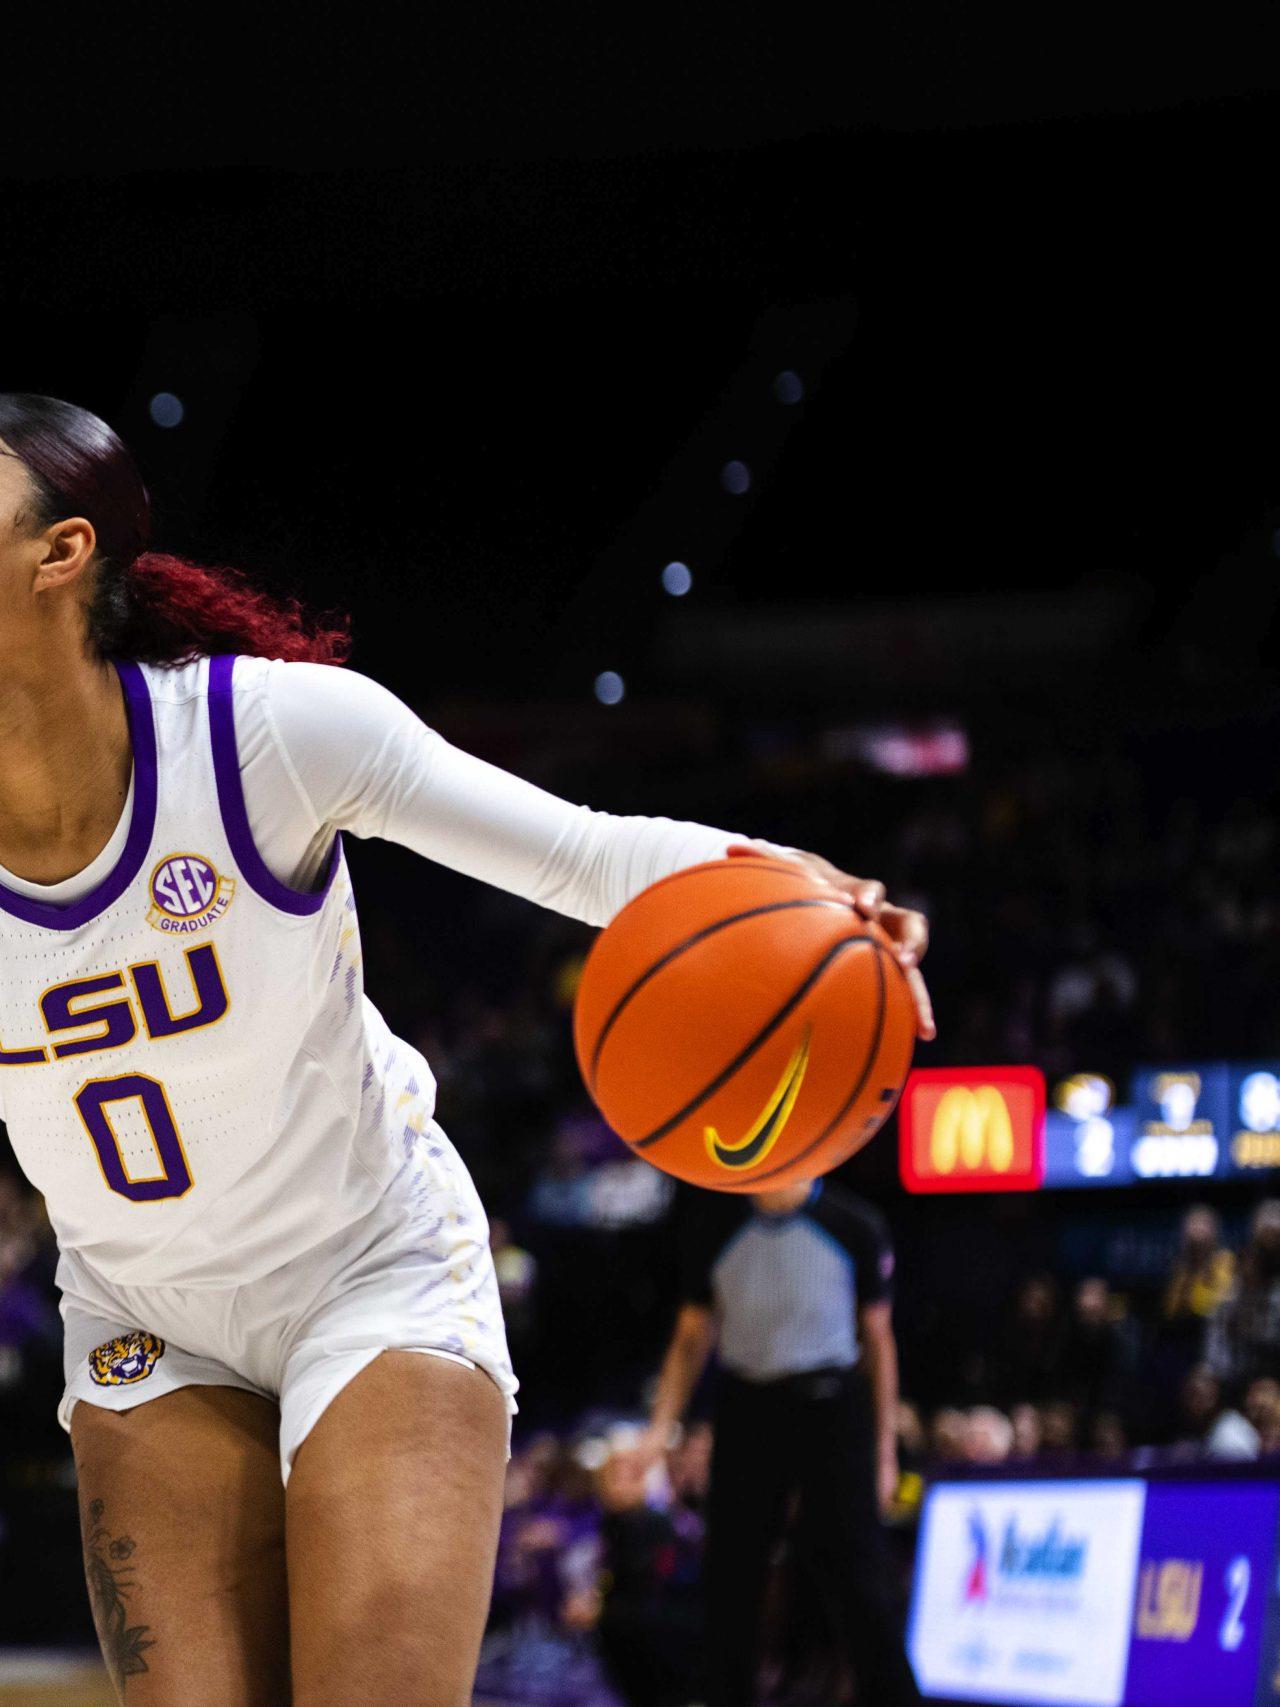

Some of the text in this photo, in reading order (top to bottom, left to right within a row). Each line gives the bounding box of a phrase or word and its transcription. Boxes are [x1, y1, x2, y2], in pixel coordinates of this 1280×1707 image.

[155, 858, 214, 914] SEC
[160, 896, 229, 932] GRADUATE
[72, 1071, 196, 1202] 0
[1136, 1554, 1252, 1651] LSU 2
